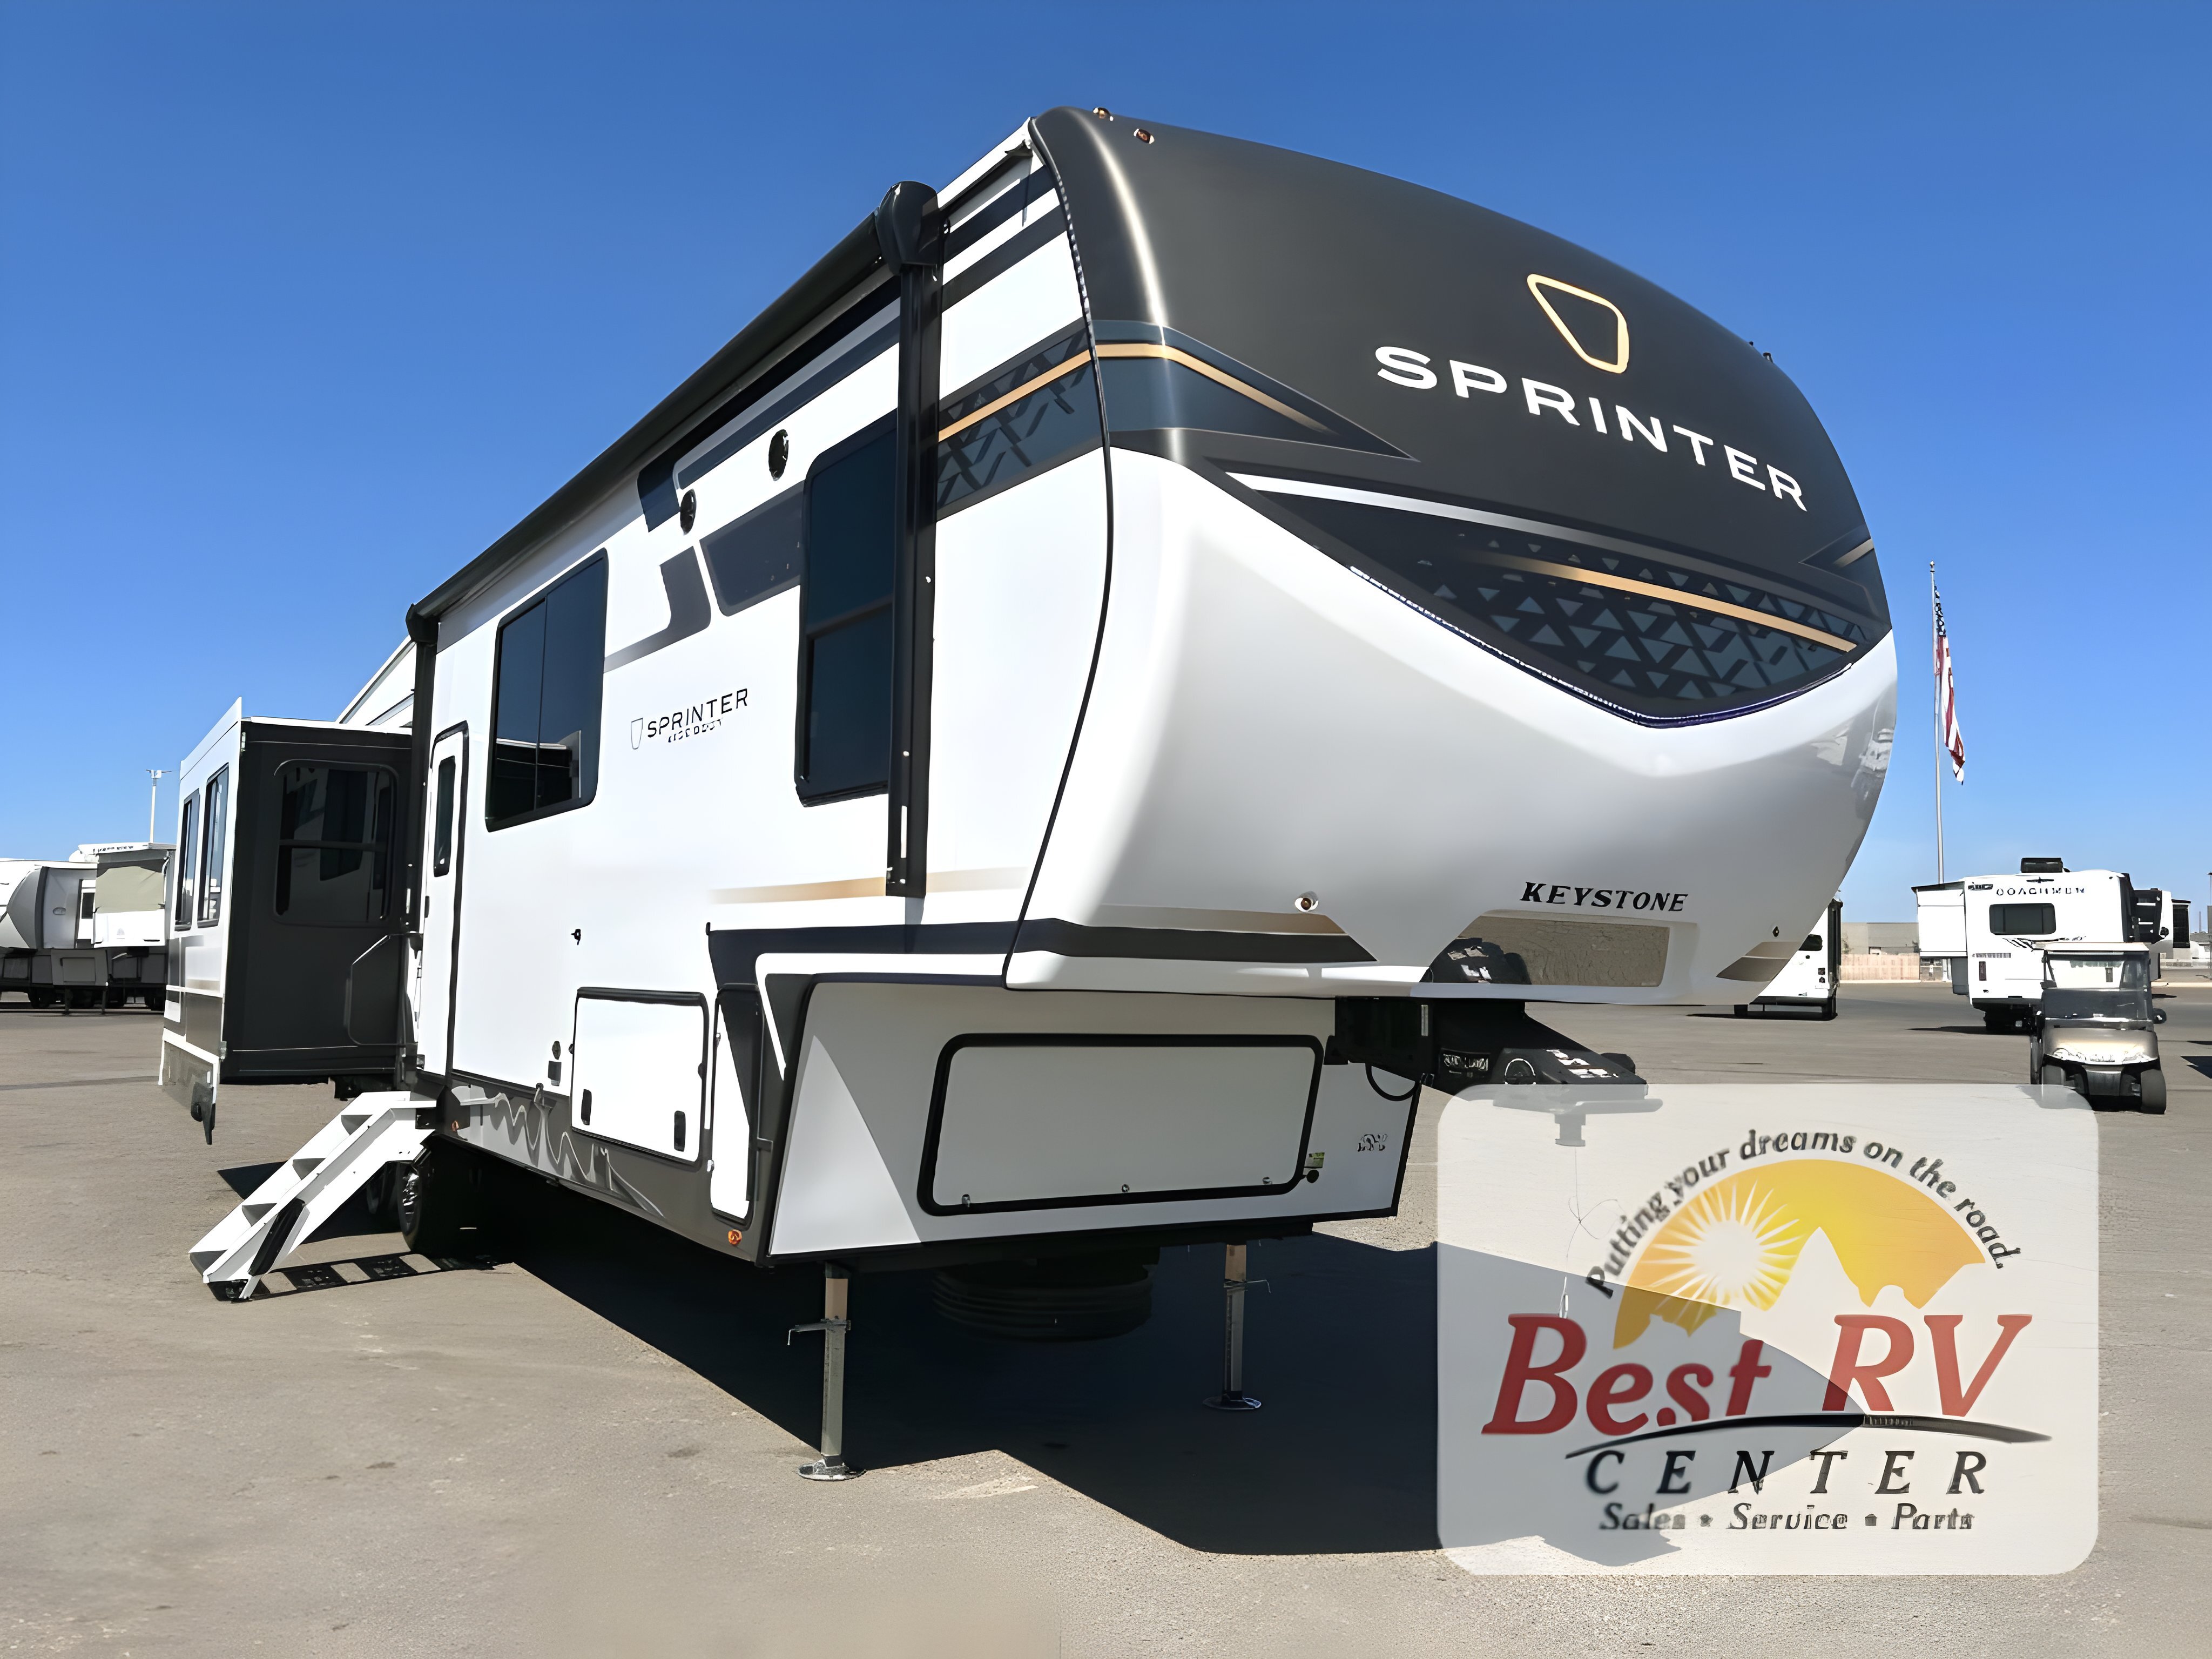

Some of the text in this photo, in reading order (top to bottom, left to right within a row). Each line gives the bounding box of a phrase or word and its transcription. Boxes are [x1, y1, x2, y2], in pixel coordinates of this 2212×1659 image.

[1375, 346, 1808, 512] SPRINTER
[647, 688, 748, 738] SPRINTER
[1520, 881, 1689, 912] KEYSTONE
